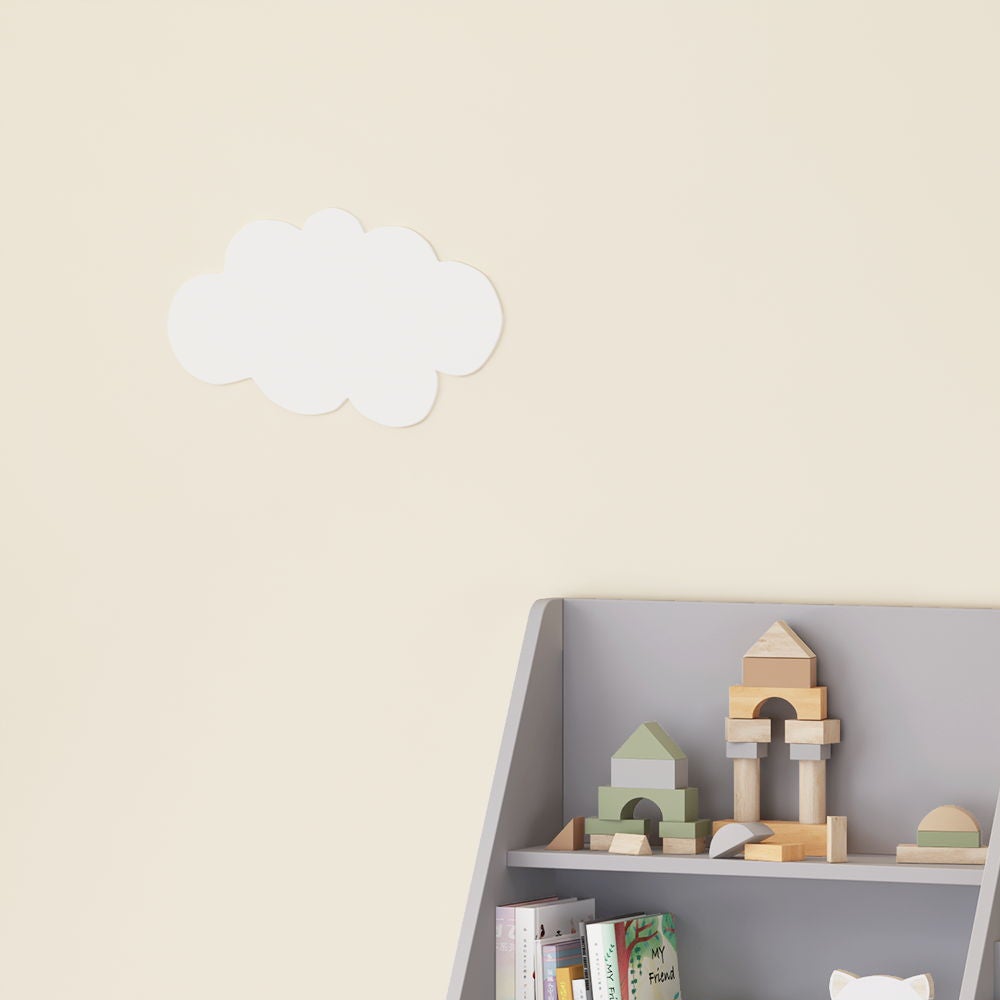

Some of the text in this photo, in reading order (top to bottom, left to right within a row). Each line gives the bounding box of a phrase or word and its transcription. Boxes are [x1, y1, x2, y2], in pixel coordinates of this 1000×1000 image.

[651, 946, 665, 964] MY
[606, 964, 615, 981] MY
[648, 967, 676, 985] Friend
